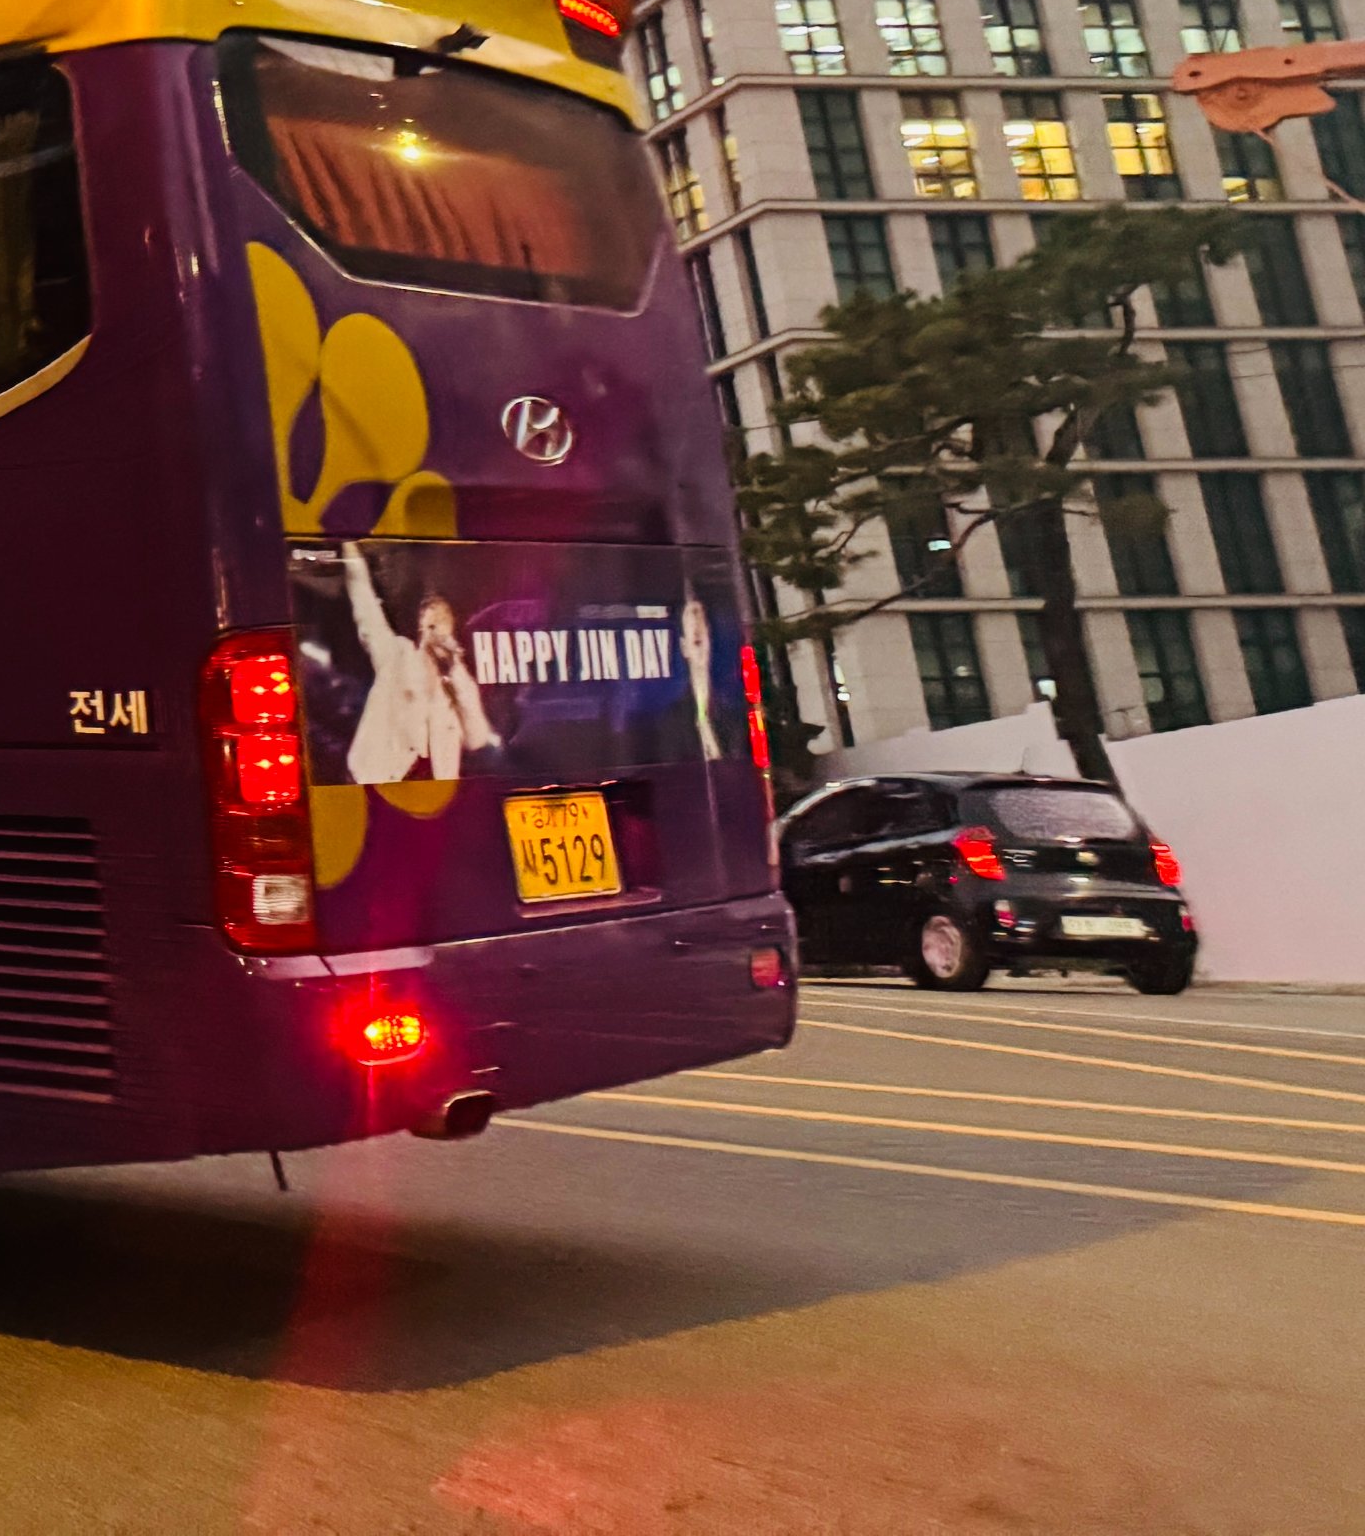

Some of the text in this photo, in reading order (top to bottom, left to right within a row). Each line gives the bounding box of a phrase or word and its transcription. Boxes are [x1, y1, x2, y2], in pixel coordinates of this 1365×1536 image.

[473, 628, 671, 684] HAPPY JIN DAY
[69, 690, 149, 734] 전세
